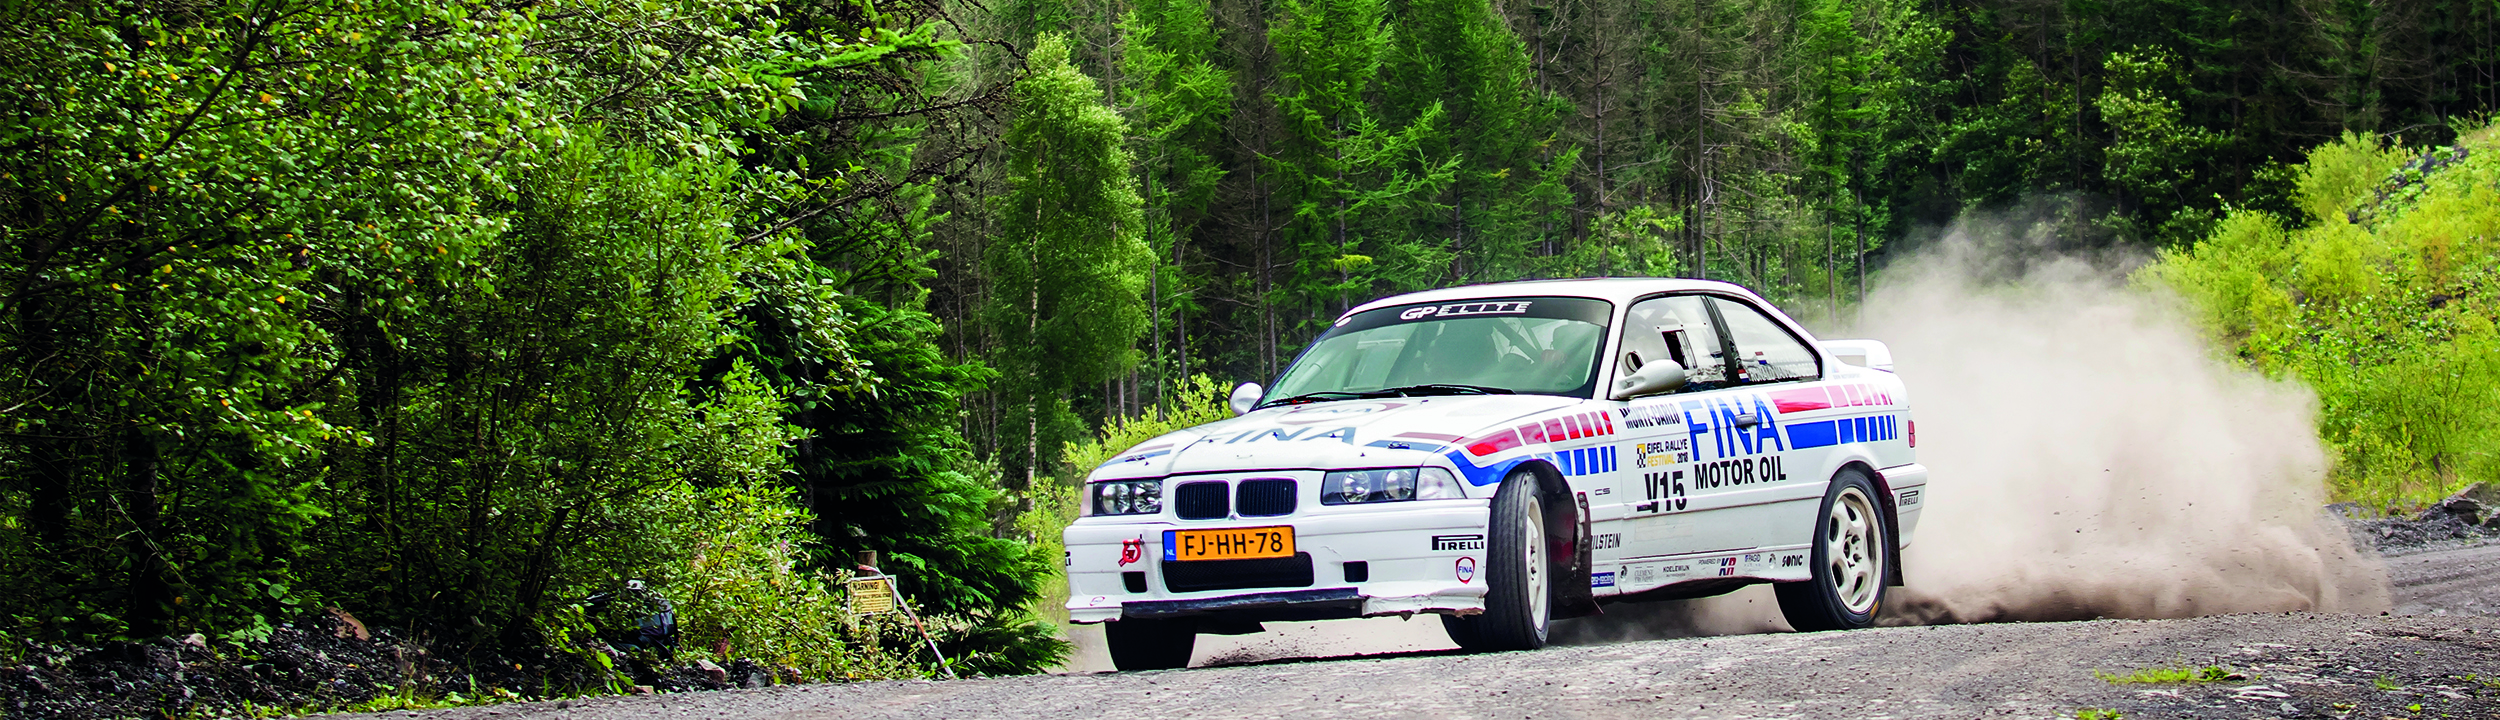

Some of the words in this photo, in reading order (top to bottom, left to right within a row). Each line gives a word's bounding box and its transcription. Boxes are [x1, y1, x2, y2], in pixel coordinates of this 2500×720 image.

[1679, 394, 1784, 461] FINA
[1200, 427, 1356, 445] FINA
[1646, 442, 1664, 453] EIFEL
[1665, 438, 1688, 450] RALLYE
[1646, 454, 1676, 467] FESTIVAL
[1677, 452, 1689, 463] 2018
[1694, 459, 1755, 490] MOTOR
[1759, 455, 1786, 483] OIL
[1595, 487, 1610, 496] CS
[1644, 470, 1688, 513] V15
[1899, 490, 1919, 506] PIRELLI
[1184, 532, 1283, 556] FJ-HH-78
[1431, 534, 1484, 551] PIRELLI
[1458, 565, 1473, 573] FINA
[1782, 555, 1803, 567] SONIC
